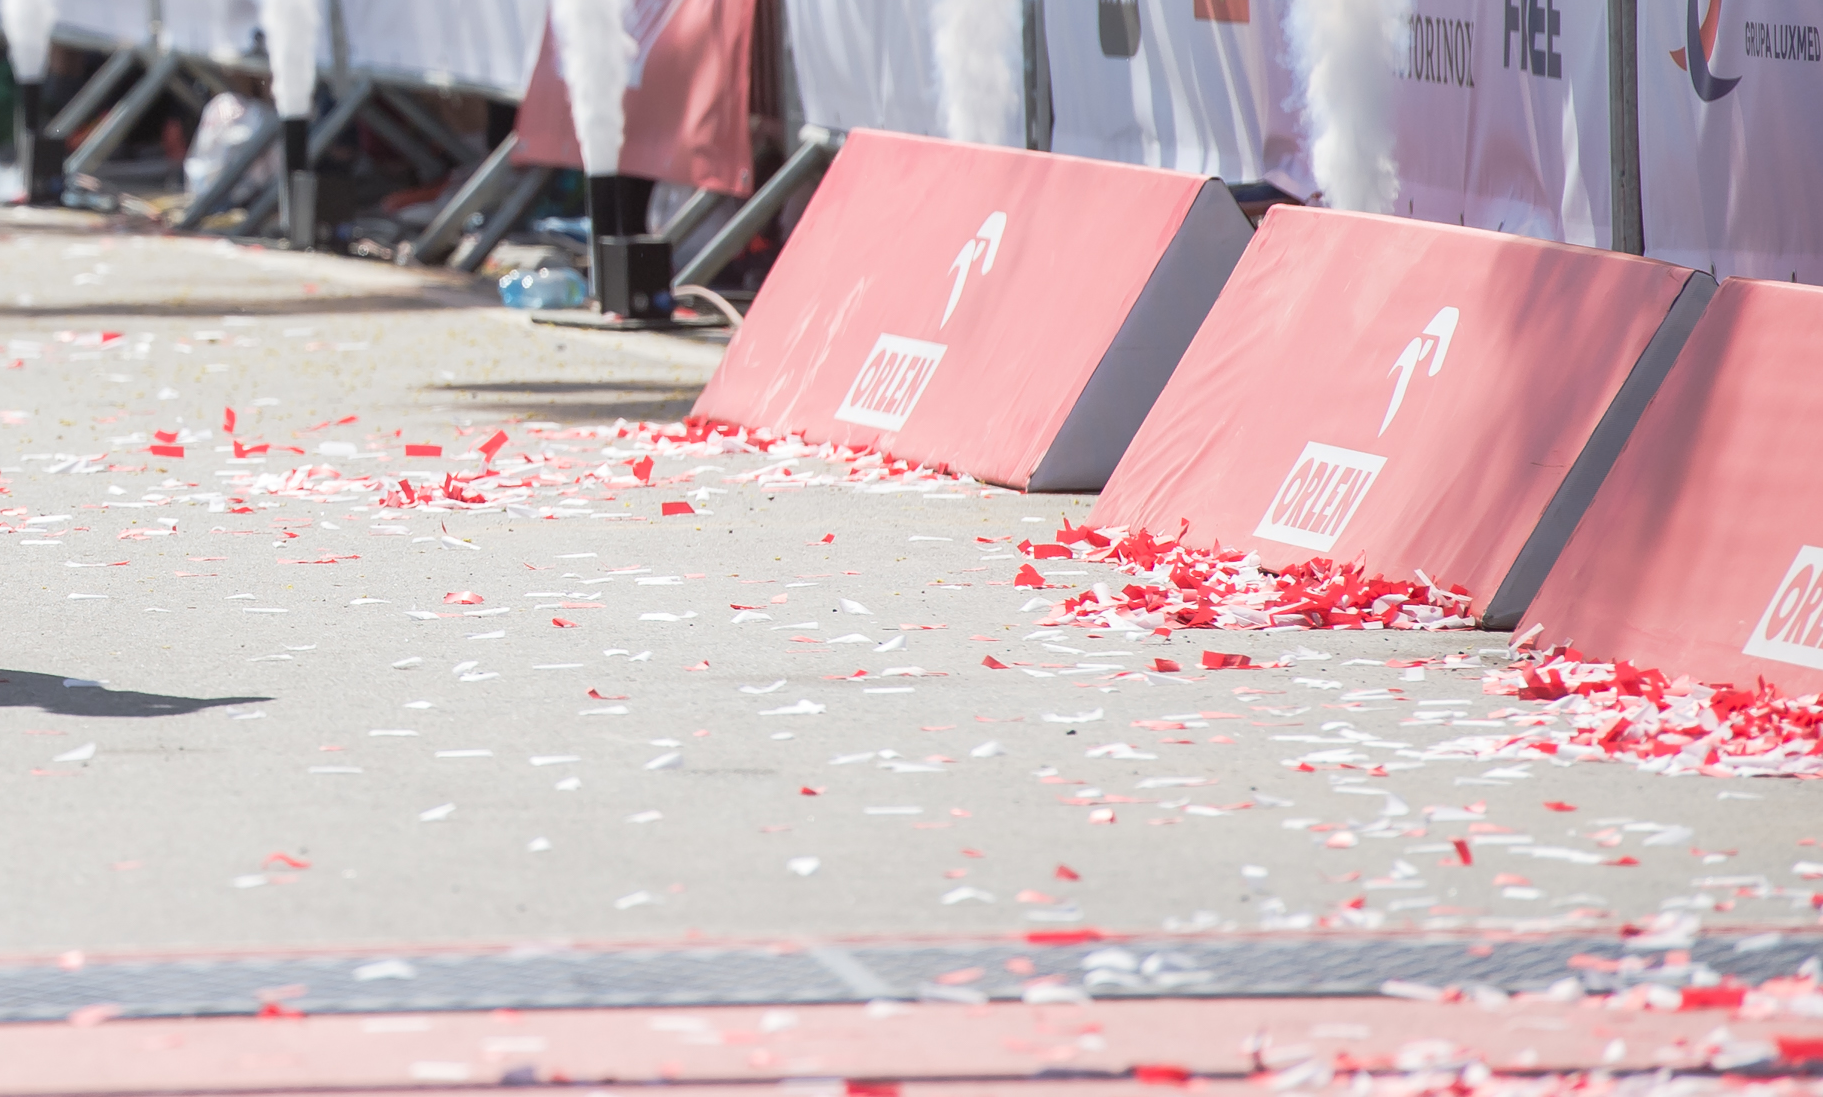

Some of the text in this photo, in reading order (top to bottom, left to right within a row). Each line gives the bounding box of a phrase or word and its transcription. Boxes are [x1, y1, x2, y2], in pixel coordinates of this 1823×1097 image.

[1404, 13, 1475, 88] TORINOX
[1745, 21, 1821, 62] GRUPA LUXMED
[850, 347, 936, 418] ORLEN
[1271, 457, 1373, 537] ORLEN
